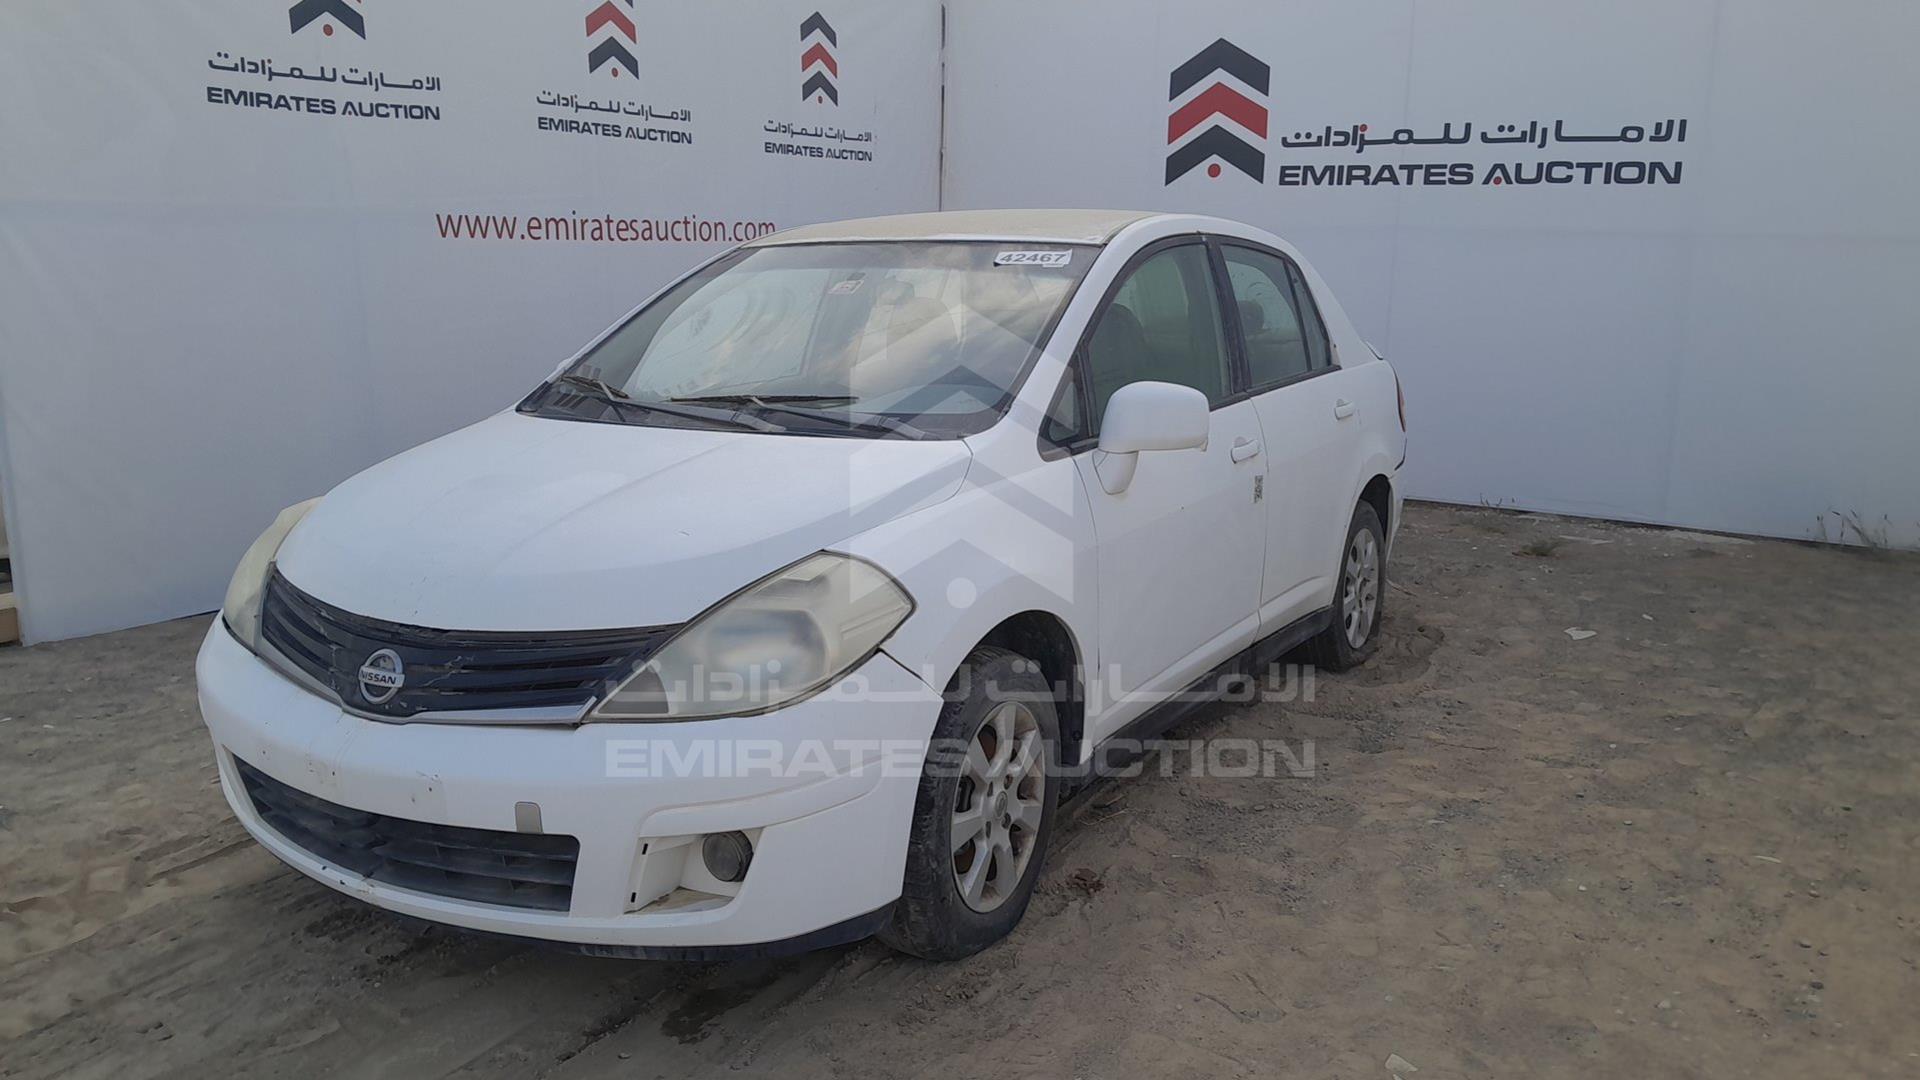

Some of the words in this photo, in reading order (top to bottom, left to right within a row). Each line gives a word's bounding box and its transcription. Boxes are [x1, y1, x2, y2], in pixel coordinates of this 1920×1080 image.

[208, 51, 337, 82] للمزادات
[341, 67, 441, 92] الامارات
[206, 86, 337, 115] EMIRATES
[341, 101, 441, 120] AUCTION
[536, 90, 621, 113] للمزادات
[623, 101, 691, 122] الامارات
[537, 116, 622, 138] EMIRATES
[625, 127, 692, 145] AUCTION
[763, 119, 823, 138] للمزادات
[824, 127, 872, 143] الامارات
[1281, 121, 1472, 153] للمزادات
[1480, 118, 1688, 149] الامارات
[764, 142, 824, 158] EMIRATES
[825, 148, 873, 162] AUCTION
[1278, 162, 1475, 187] EMIRATES
[1482, 160, 1684, 186] AUCTION
[435, 210, 776, 242] www.emiratesauction.com
[1001, 253, 1067, 263] 42467
[361, 670, 396, 684] NISSAN
